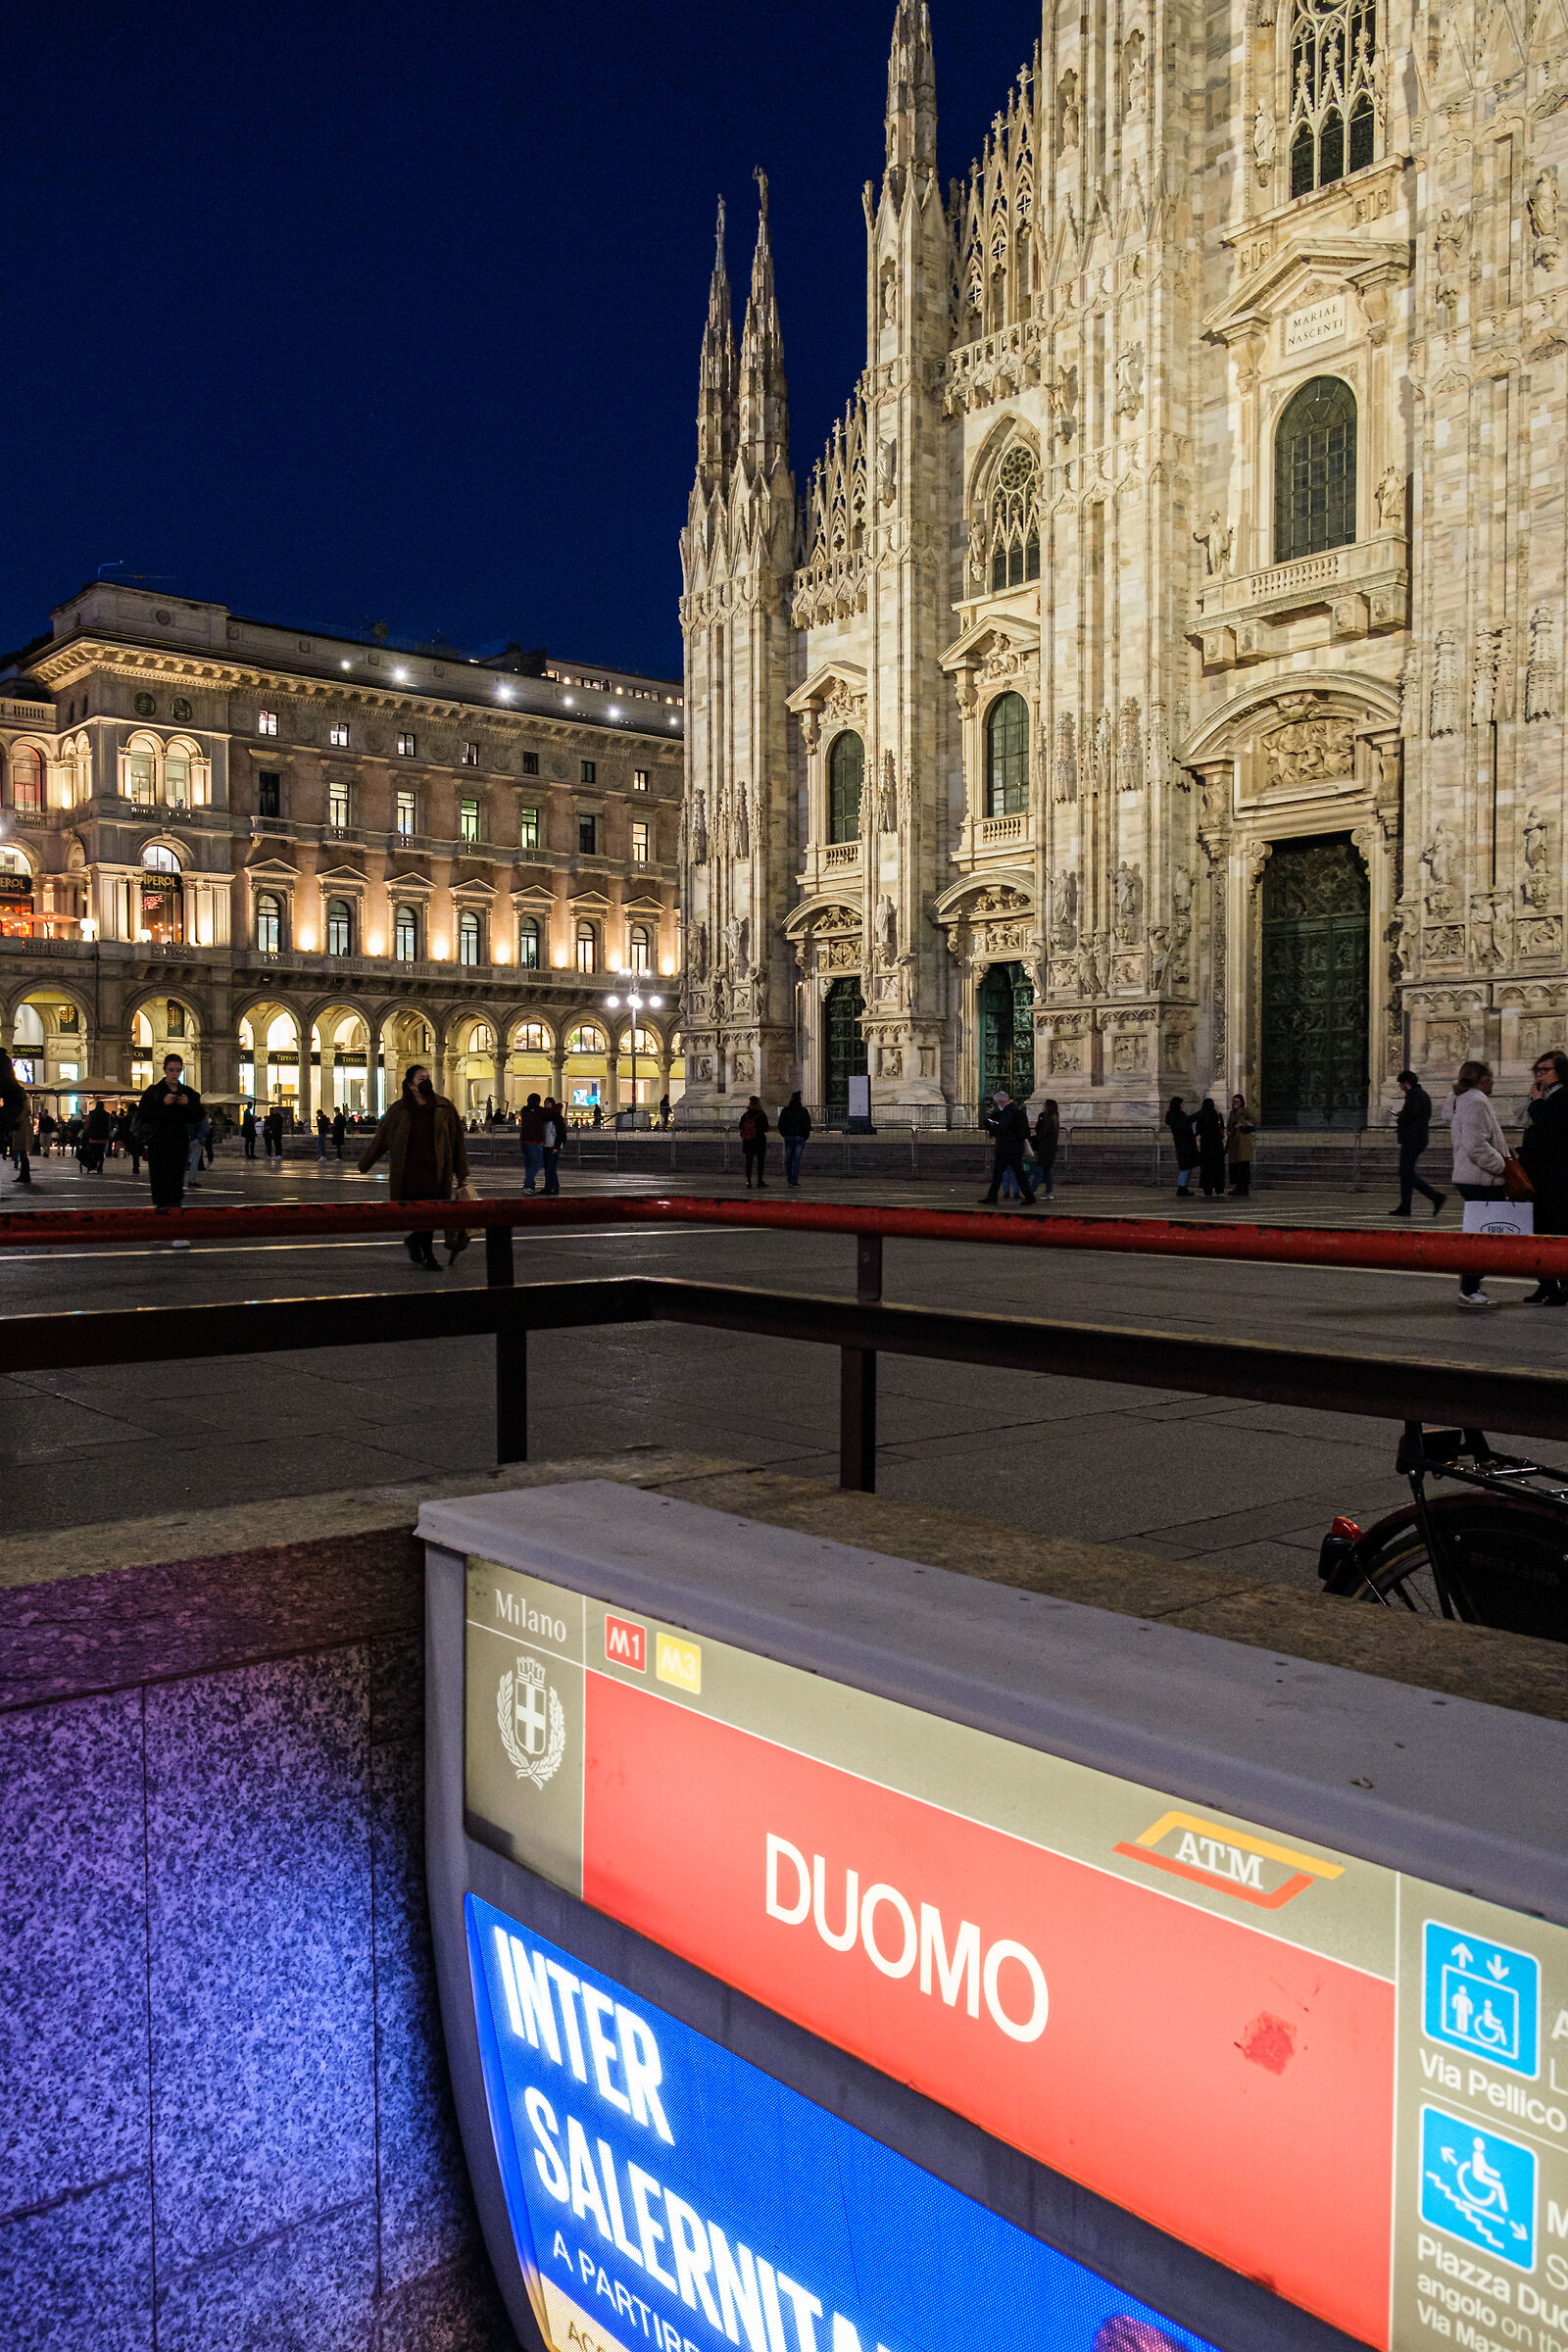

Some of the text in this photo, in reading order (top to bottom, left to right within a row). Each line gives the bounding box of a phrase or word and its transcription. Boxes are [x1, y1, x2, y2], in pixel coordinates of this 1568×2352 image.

[1288, 318, 1344, 346] NASCENTI
[1294, 304, 1338, 328] MARIAE
[495, 1589, 566, 1642] Milano
[609, 1626, 640, 1661] M1
[661, 1645, 697, 1682] M3
[1174, 1832, 1264, 1889] ATM
[765, 1832, 1050, 2043] DUOMO
[493, 1926, 676, 2146] INTER
[1419, 2047, 1567, 2133] Via Pellico
[524, 2086, 891, 2352] SALERNIT
[553, 2230, 574, 2273] A
[1418, 2232, 1511, 2304] Piazza
[1417, 2274, 1497, 2328] angolo
[1500, 2317, 1533, 2347] on
[1417, 2298, 1451, 2337] Via
